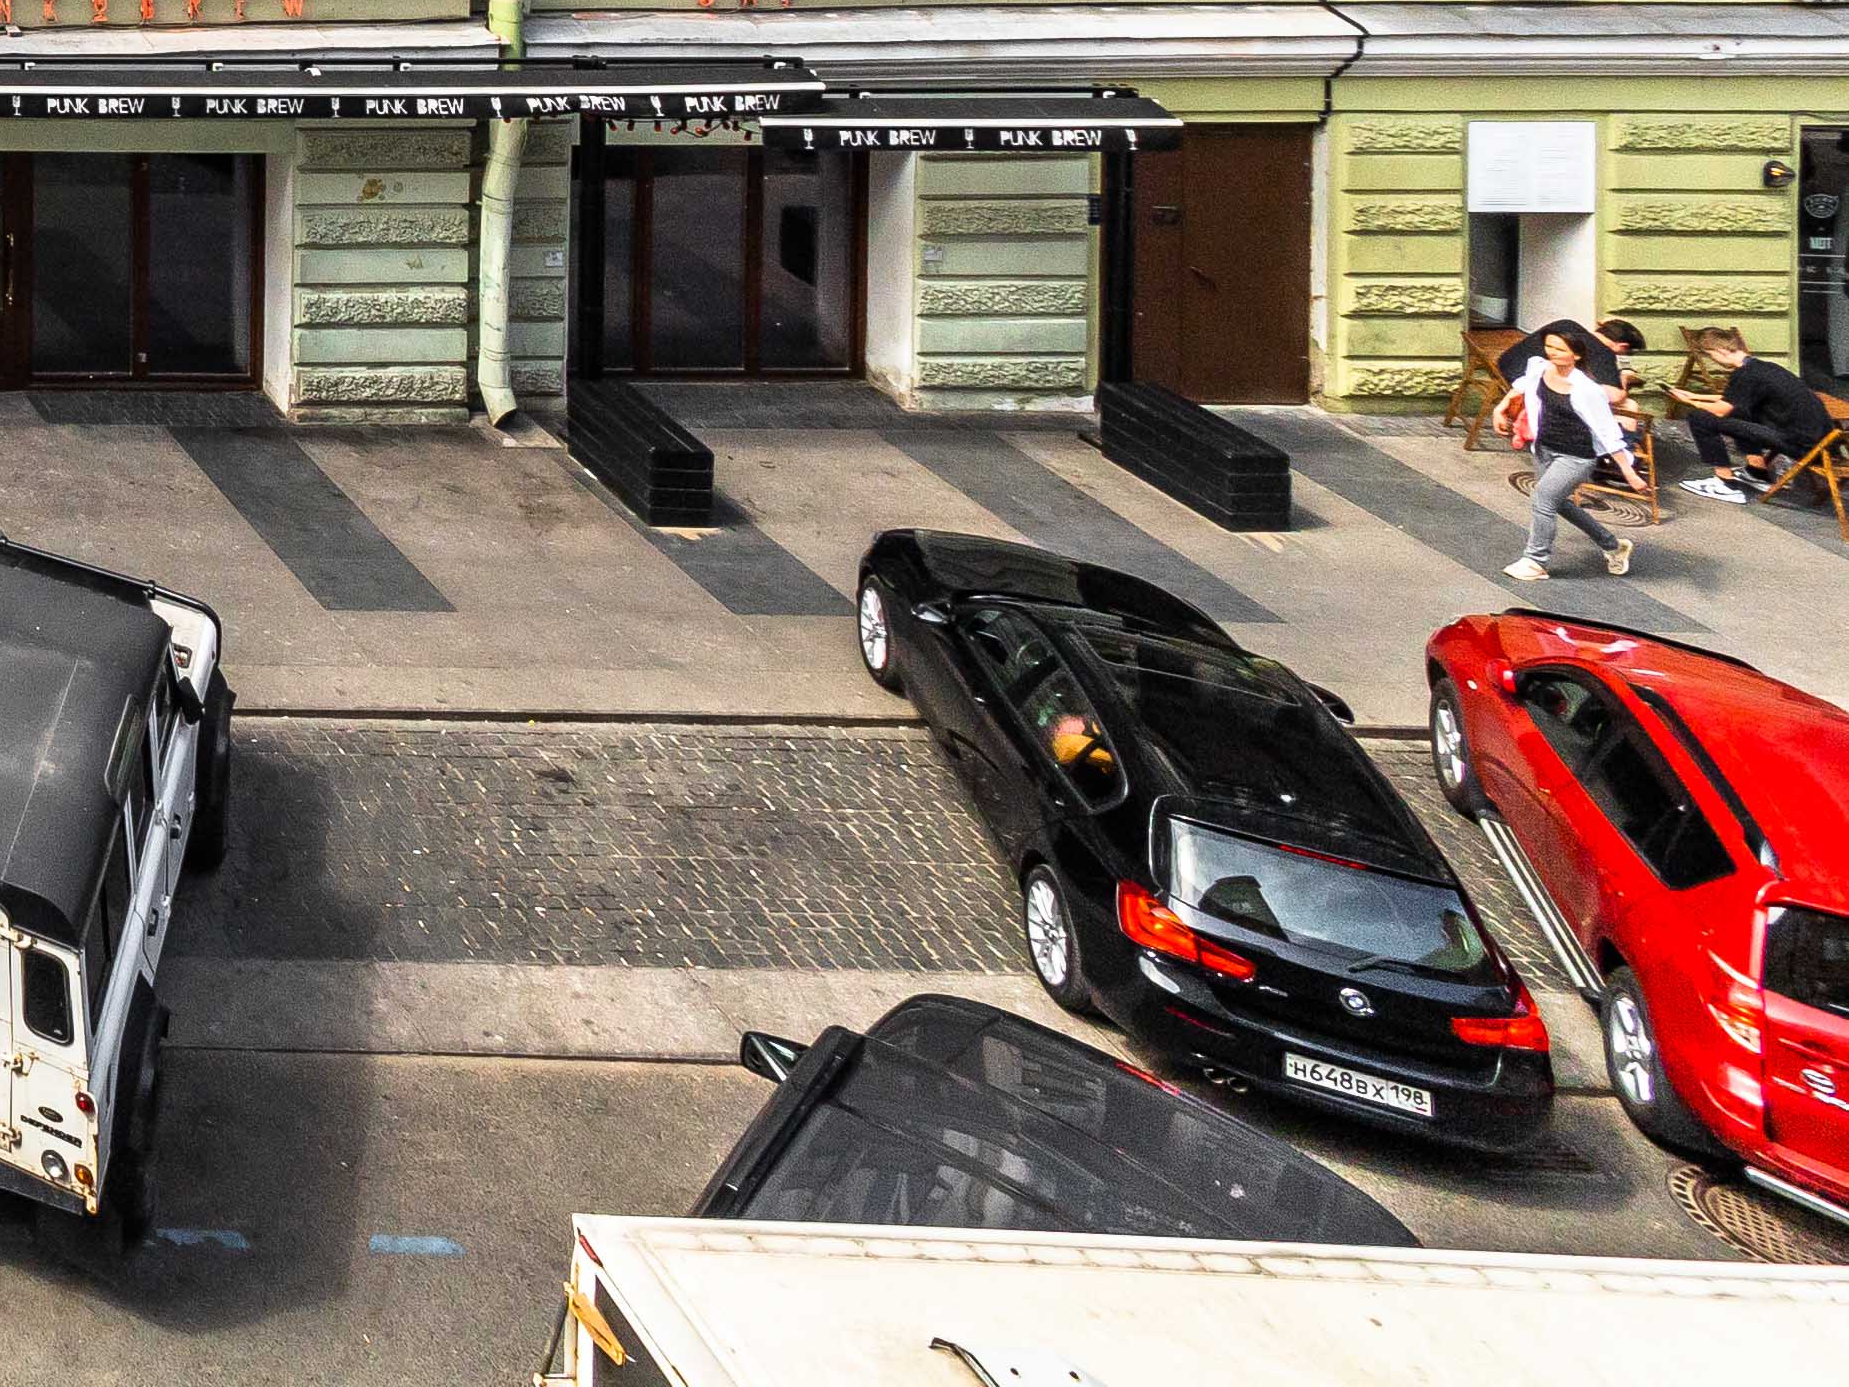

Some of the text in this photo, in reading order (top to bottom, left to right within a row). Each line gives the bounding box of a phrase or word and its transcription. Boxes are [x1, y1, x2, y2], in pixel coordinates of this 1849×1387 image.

[47, 97, 89, 114] PUNK
[98, 98, 145, 114] BREW
[206, 98, 248, 115] PUNK
[257, 98, 304, 115] BREW
[366, 98, 408, 115] PUNK
[417, 98, 464, 115] BREW
[526, 96, 571, 113] PUNK
[579, 95, 625, 111] BREW
[684, 96, 727, 113] PUNK
[735, 94, 780, 111] BREW
[839, 129, 1102, 146] PUNK BREW PUNK BREW
